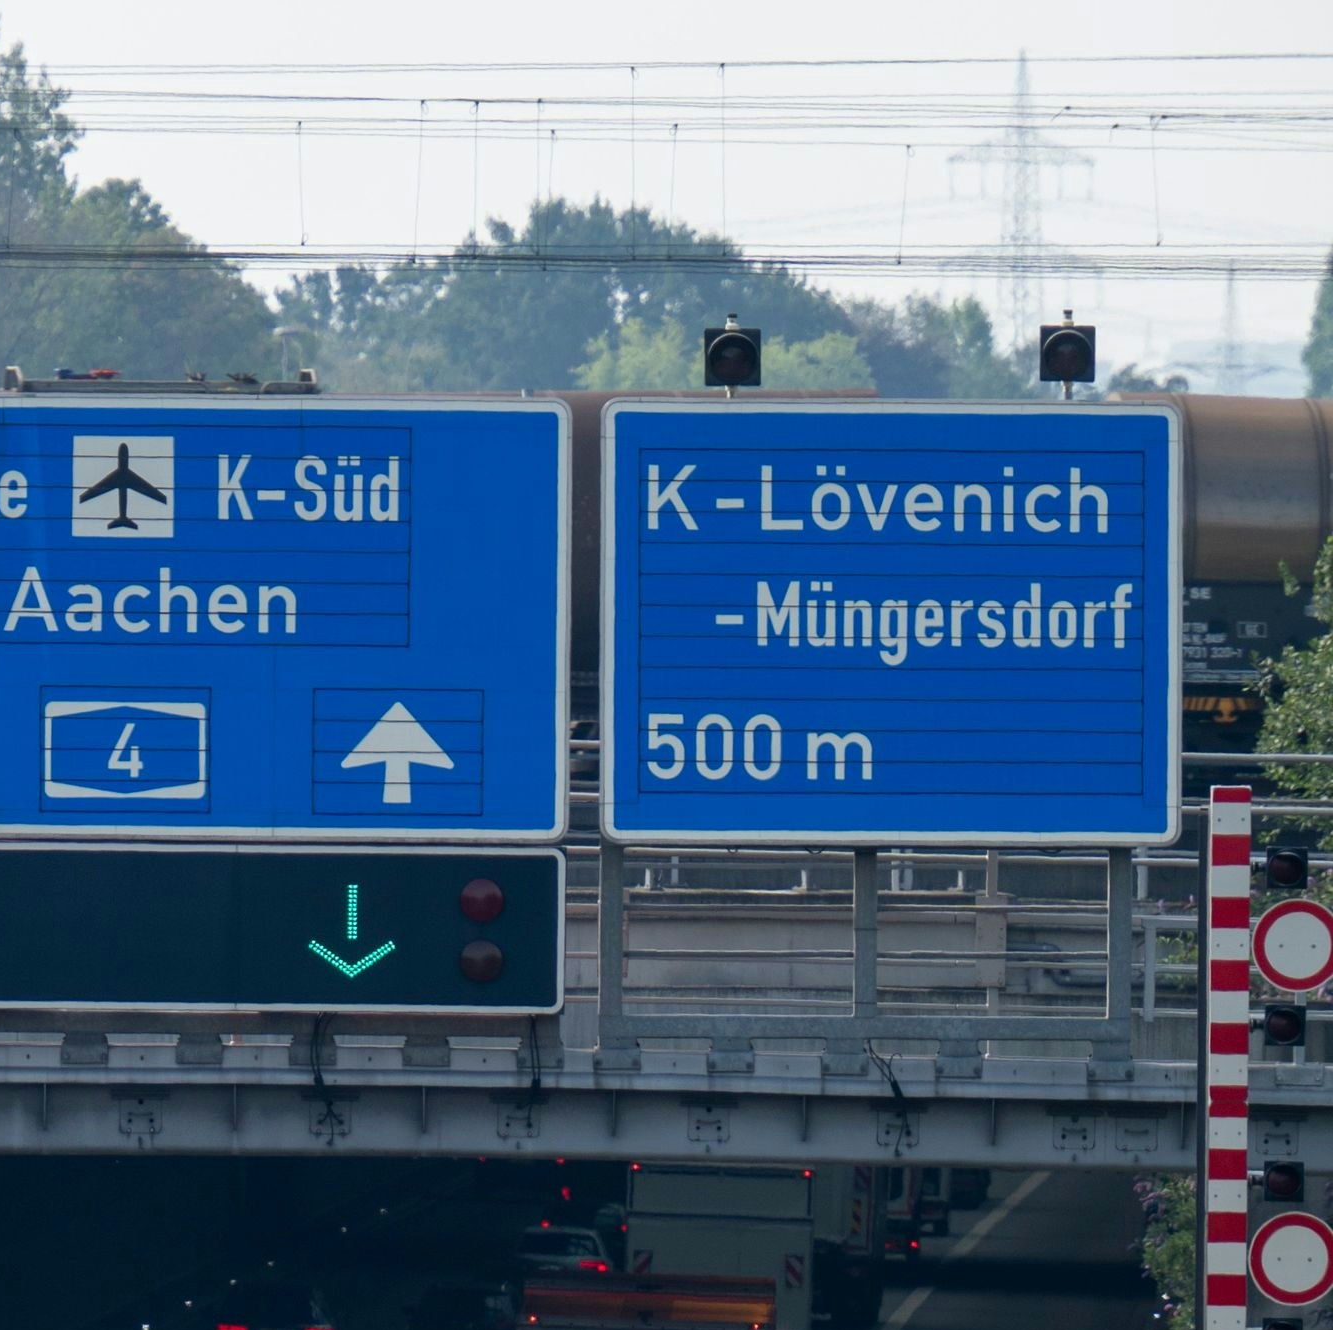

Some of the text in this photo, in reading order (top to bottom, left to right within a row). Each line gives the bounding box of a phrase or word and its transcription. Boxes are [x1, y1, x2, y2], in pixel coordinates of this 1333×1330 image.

[218, 454, 400, 522] K-Süd
[647, 464, 1110, 534] K-Lövenich
[3, 566, 298, 634] Aachen
[714, 581, 1134, 666] -Müngersdorf
[1190, 587, 1212, 599] SE
[108, 722, 144, 778] 4
[647, 713, 873, 781] 500 m
